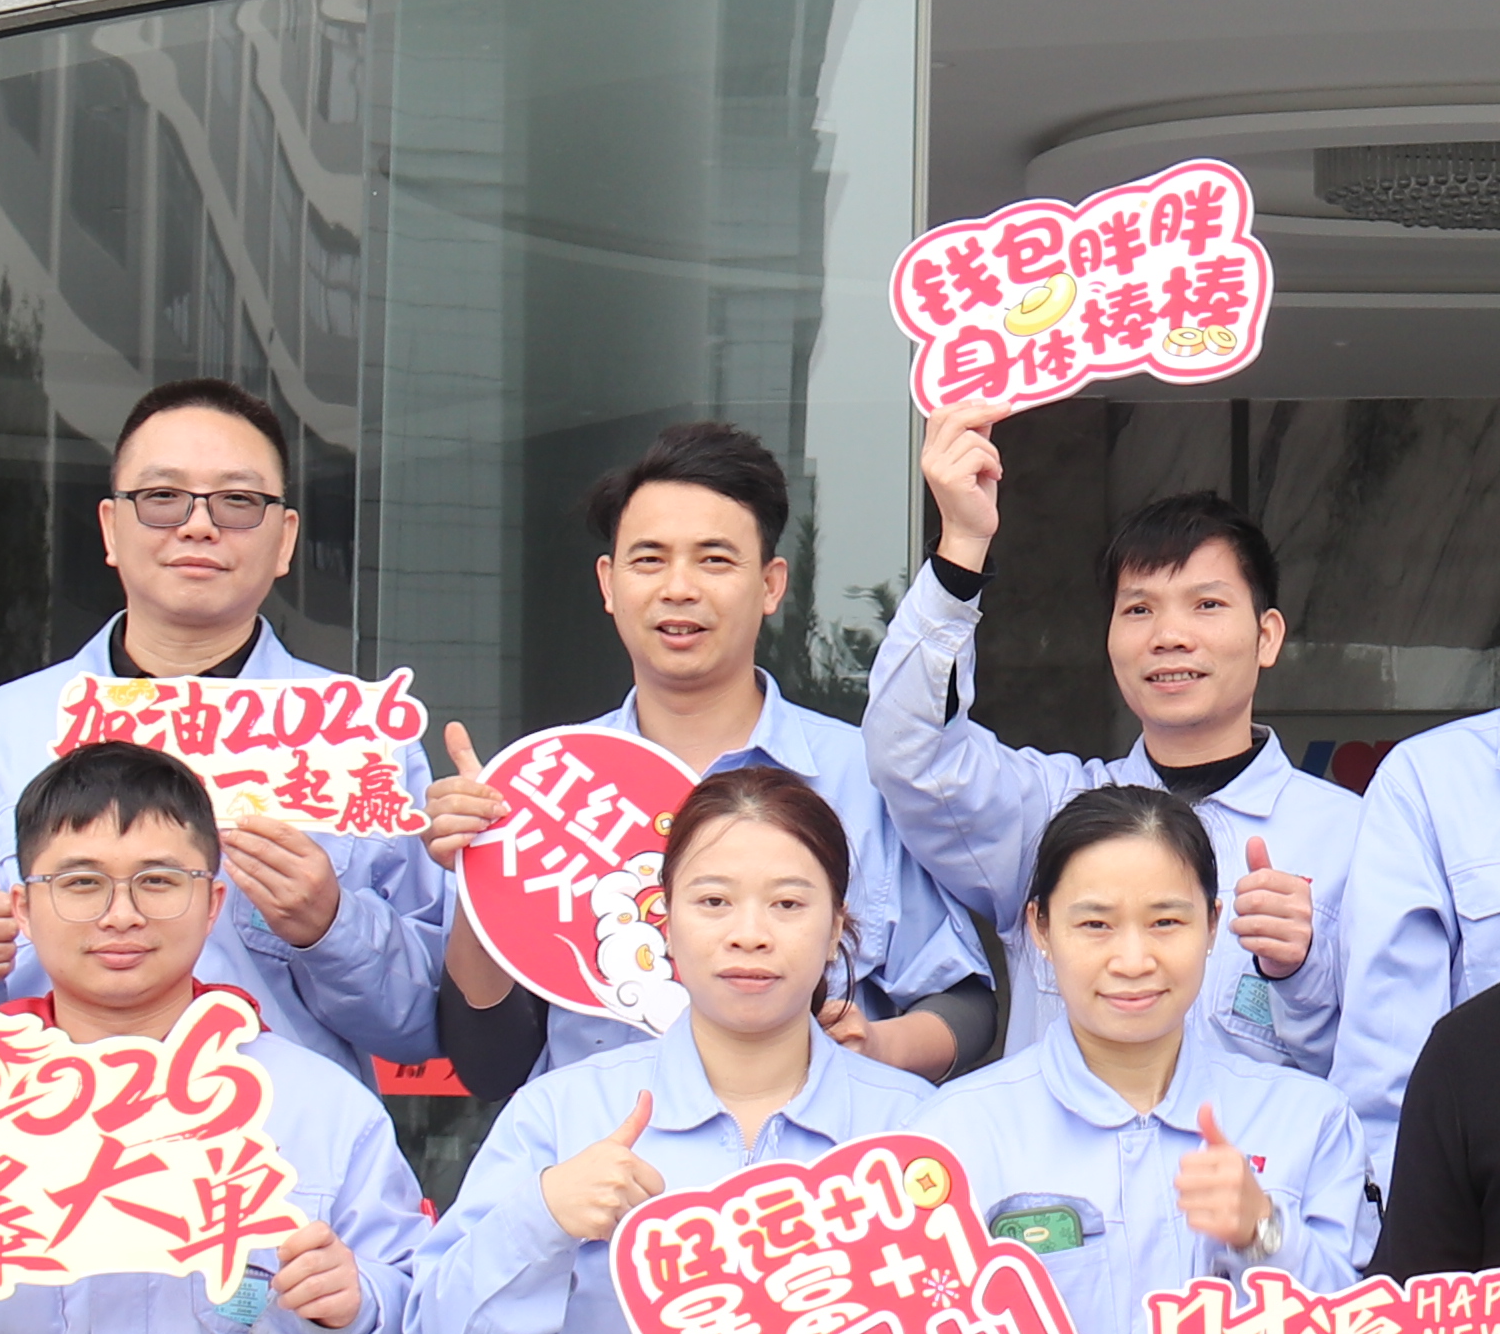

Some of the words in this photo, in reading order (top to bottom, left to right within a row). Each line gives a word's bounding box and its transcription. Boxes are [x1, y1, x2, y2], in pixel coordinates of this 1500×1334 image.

[912, 180, 1227, 325] 钱包胖胖
[938, 254, 1249, 406] 身体棒棒
[53, 673, 421, 757] 加油2026
[469, 799, 599, 923] 火火
[509, 737, 651, 867] 红红
[637, 1149, 905, 1305] 好运+1
